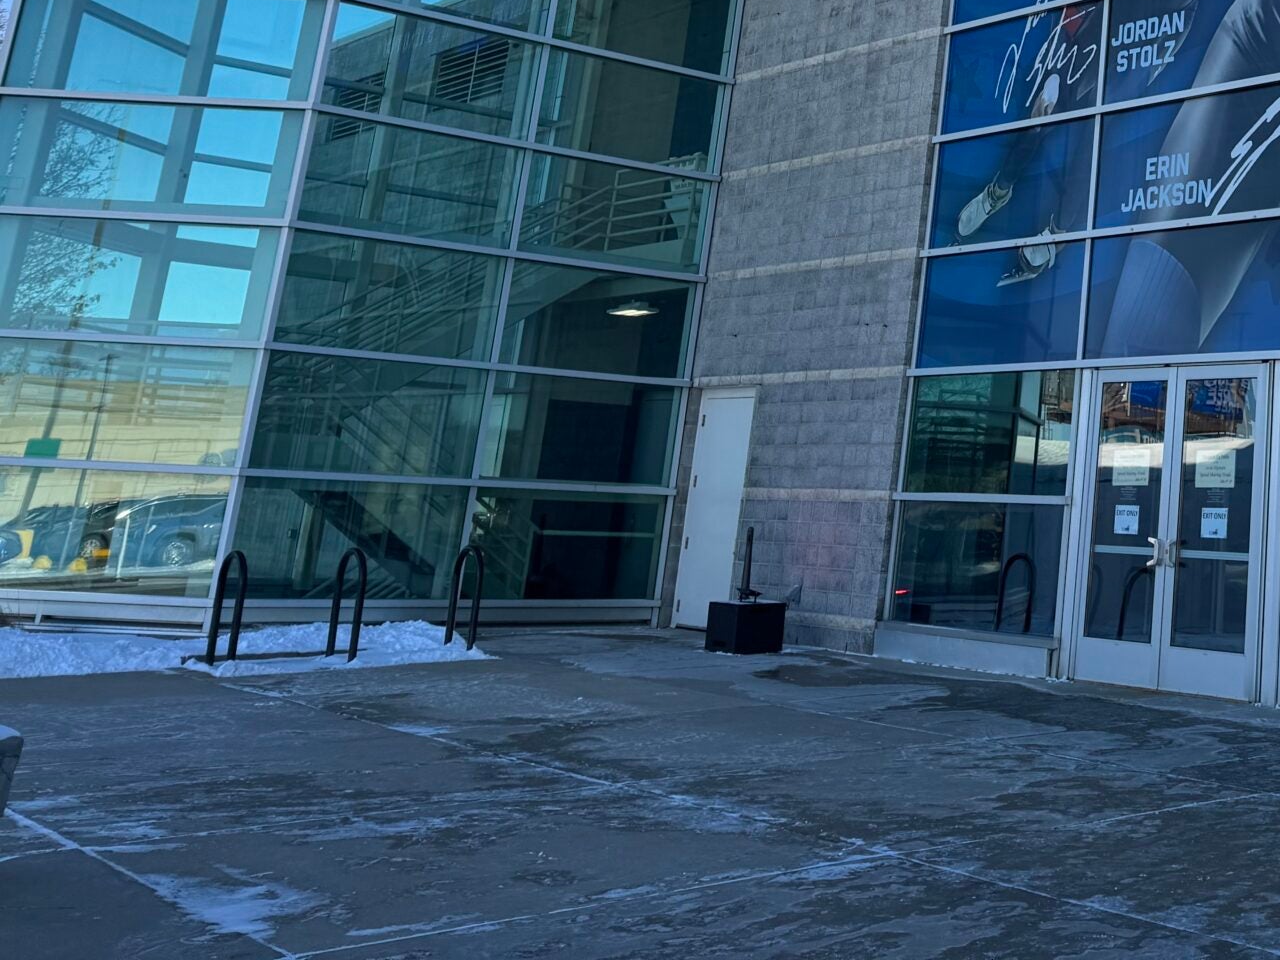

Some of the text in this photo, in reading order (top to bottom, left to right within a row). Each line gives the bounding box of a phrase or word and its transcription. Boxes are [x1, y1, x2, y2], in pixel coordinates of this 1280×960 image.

[1111, 10, 1185, 47] JORDAN
[1116, 40, 1176, 73] STOLZ
[1145, 152, 1190, 181] ERIN
[1120, 178, 1212, 214] JACKSON
[1202, 512, 1226, 520] EXIT ONLY
